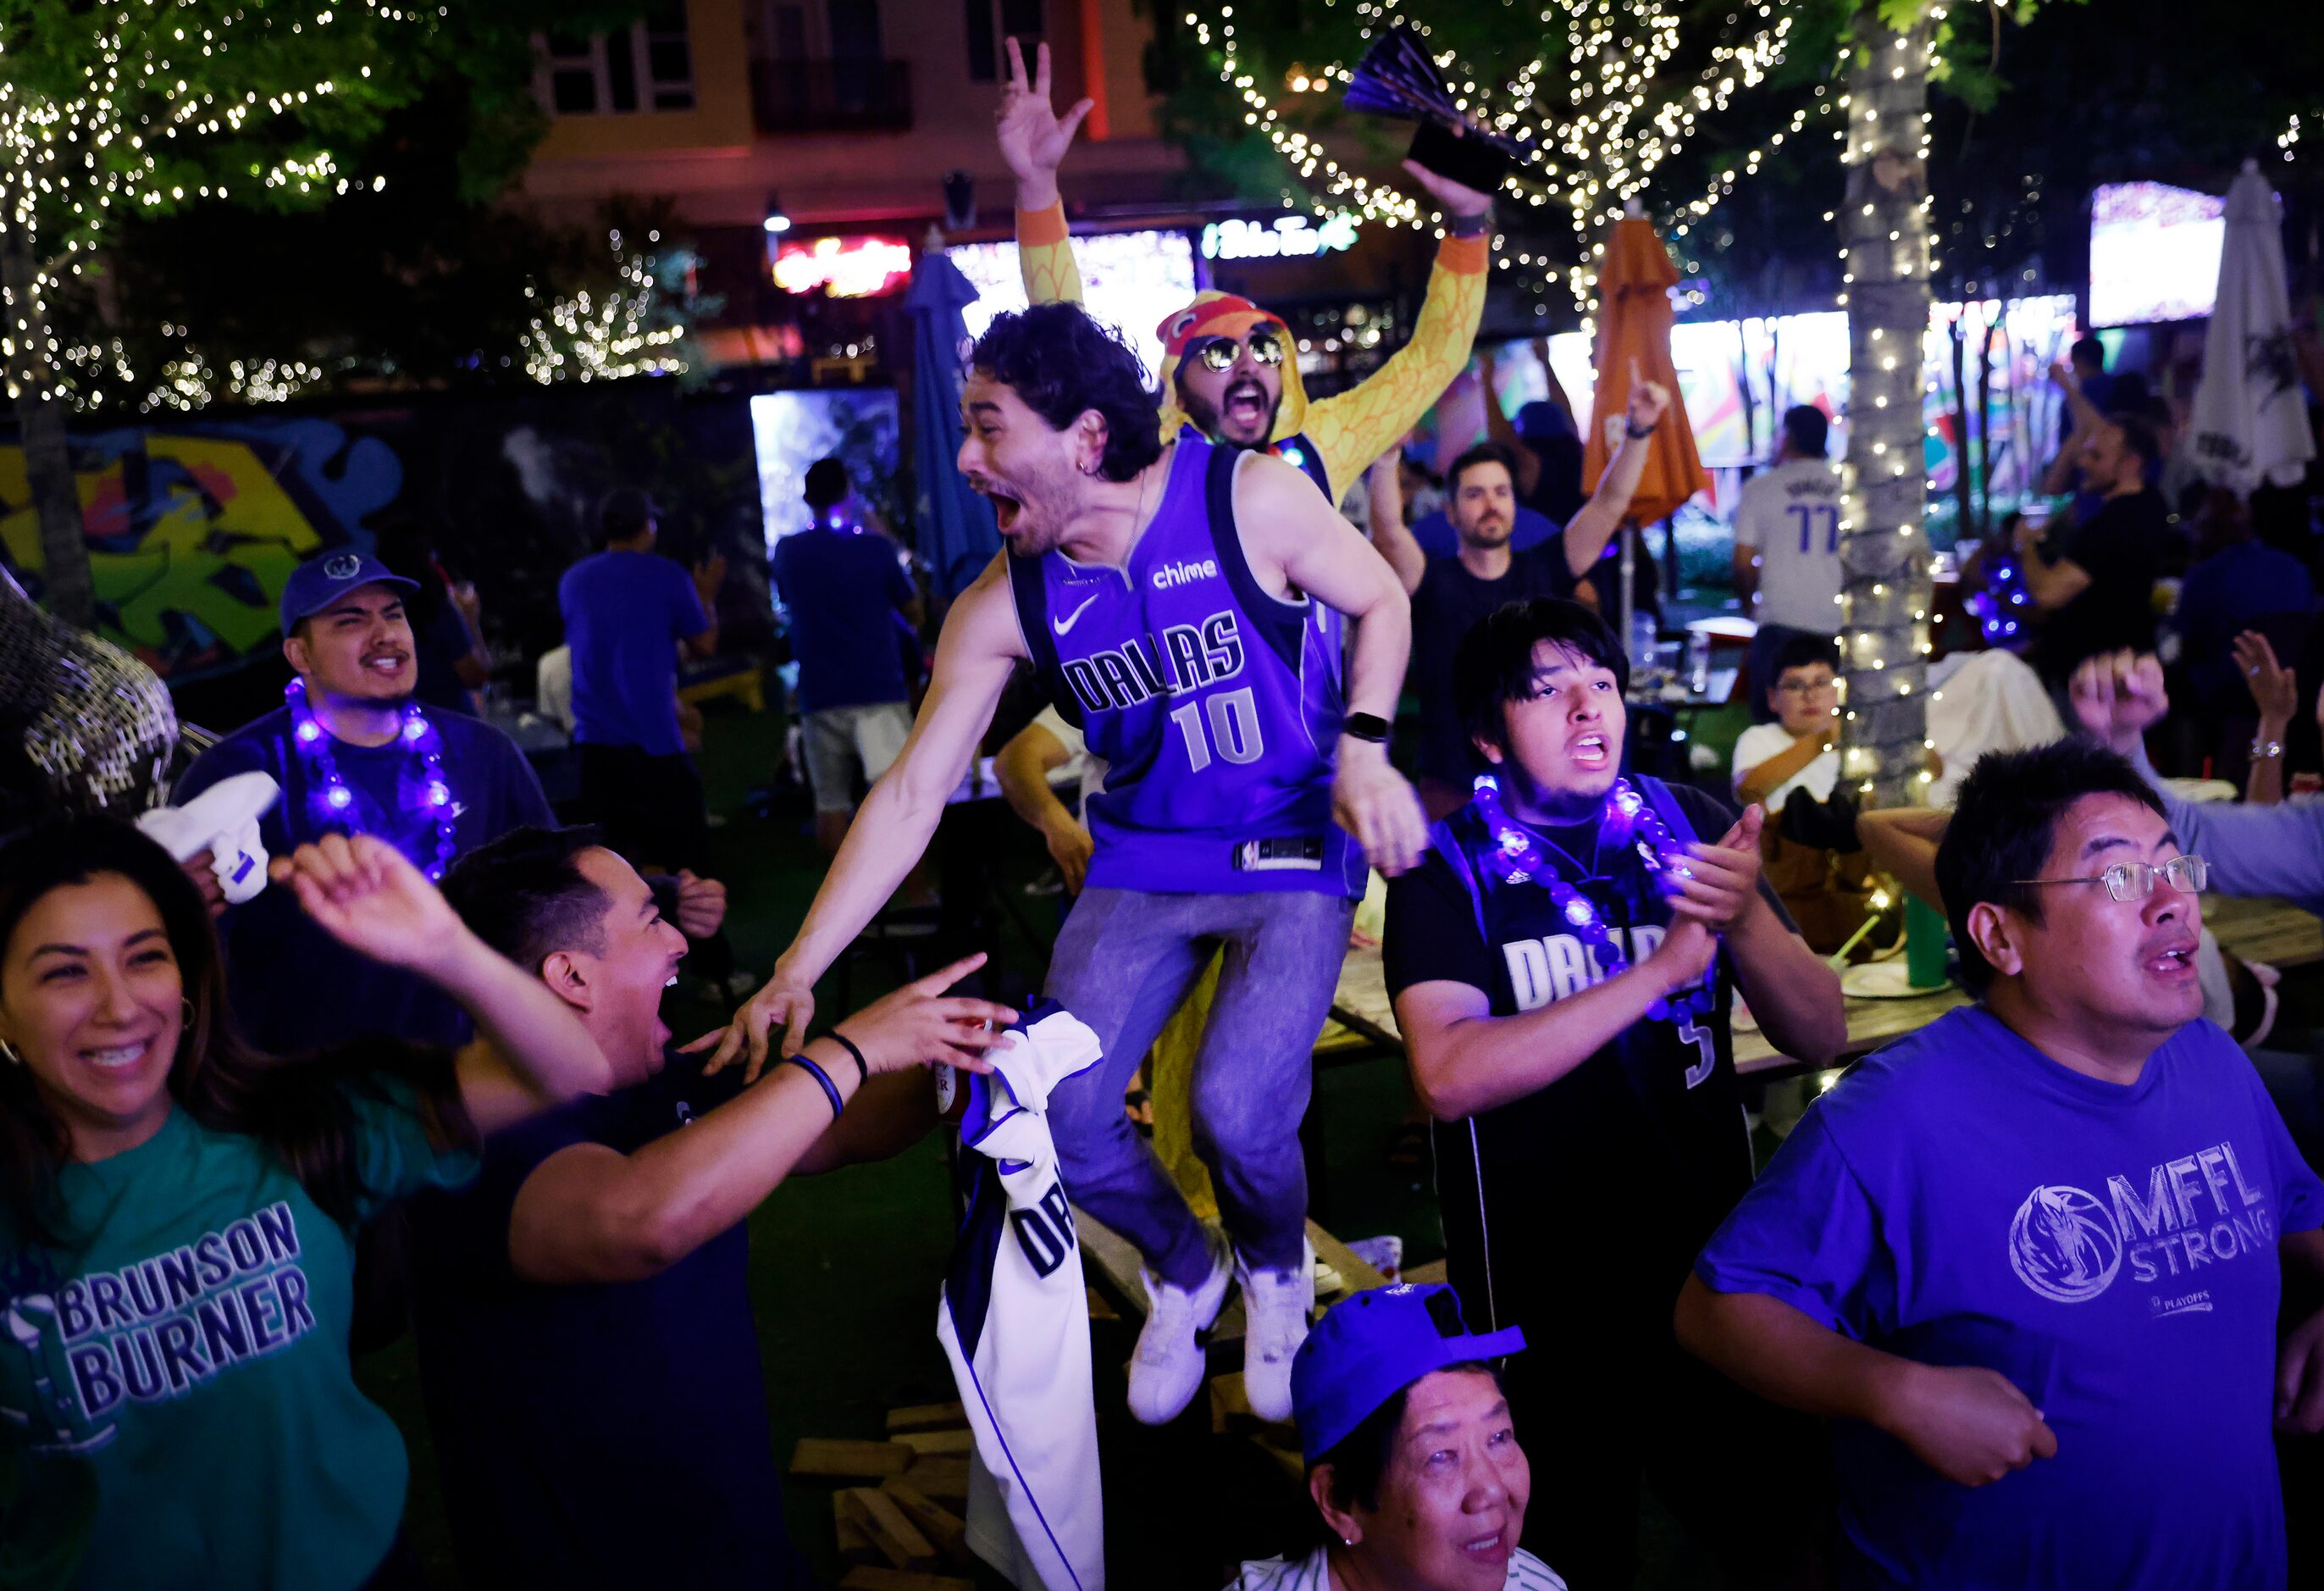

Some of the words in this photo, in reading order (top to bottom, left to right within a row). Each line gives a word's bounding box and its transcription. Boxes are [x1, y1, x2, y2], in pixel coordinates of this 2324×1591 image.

[1786, 504, 1838, 553] 77
[1153, 559, 1218, 590] chime
[1060, 609, 1245, 713] DALLAS
[1170, 686, 1264, 773] 10
[2107, 1141, 2265, 1242] MFFL
[55, 1200, 302, 1344] BRUNSON
[2129, 1208, 2274, 1283] STRONG
[65, 1264, 317, 1421] BURNER
[2164, 1289, 2210, 1310] PLAYOFFS
